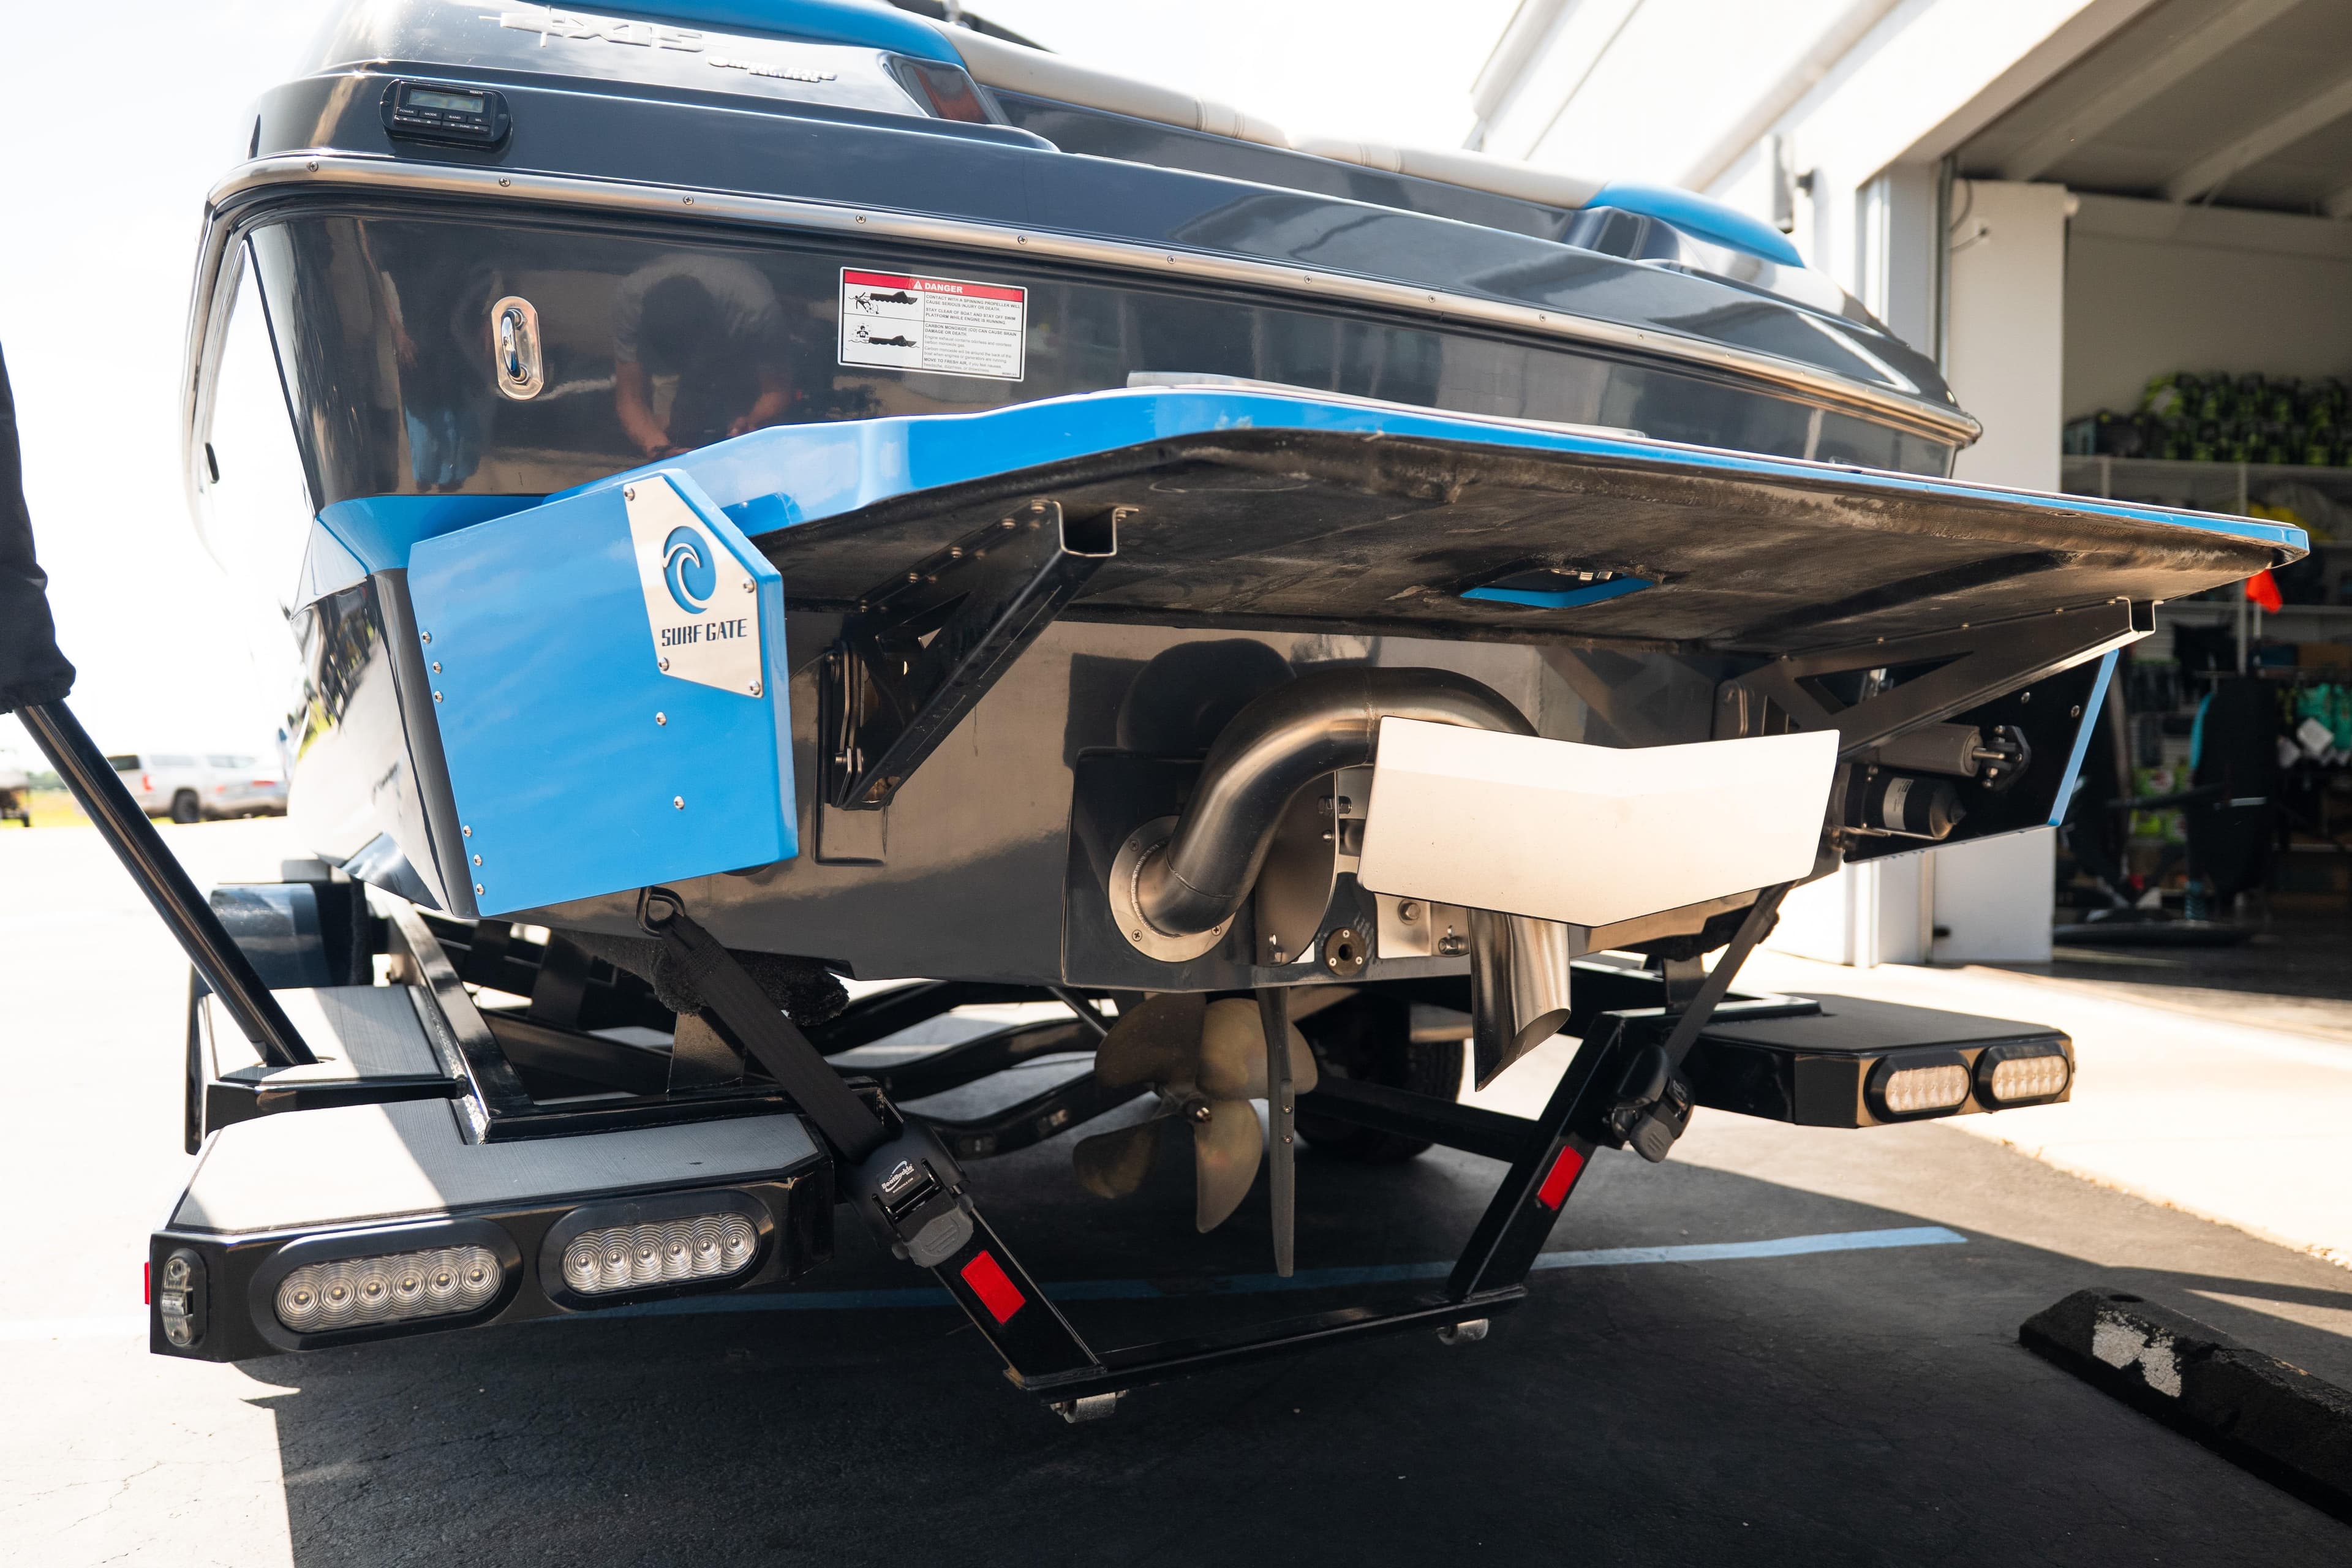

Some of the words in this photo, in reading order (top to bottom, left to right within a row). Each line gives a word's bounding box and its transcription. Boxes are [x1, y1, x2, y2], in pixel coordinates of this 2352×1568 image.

[925, 282, 963, 293] DANGER
[662, 624, 703, 646] SURF
[706, 619, 747, 641] GATE
[881, 1165, 913, 1189] BoatBuckle
